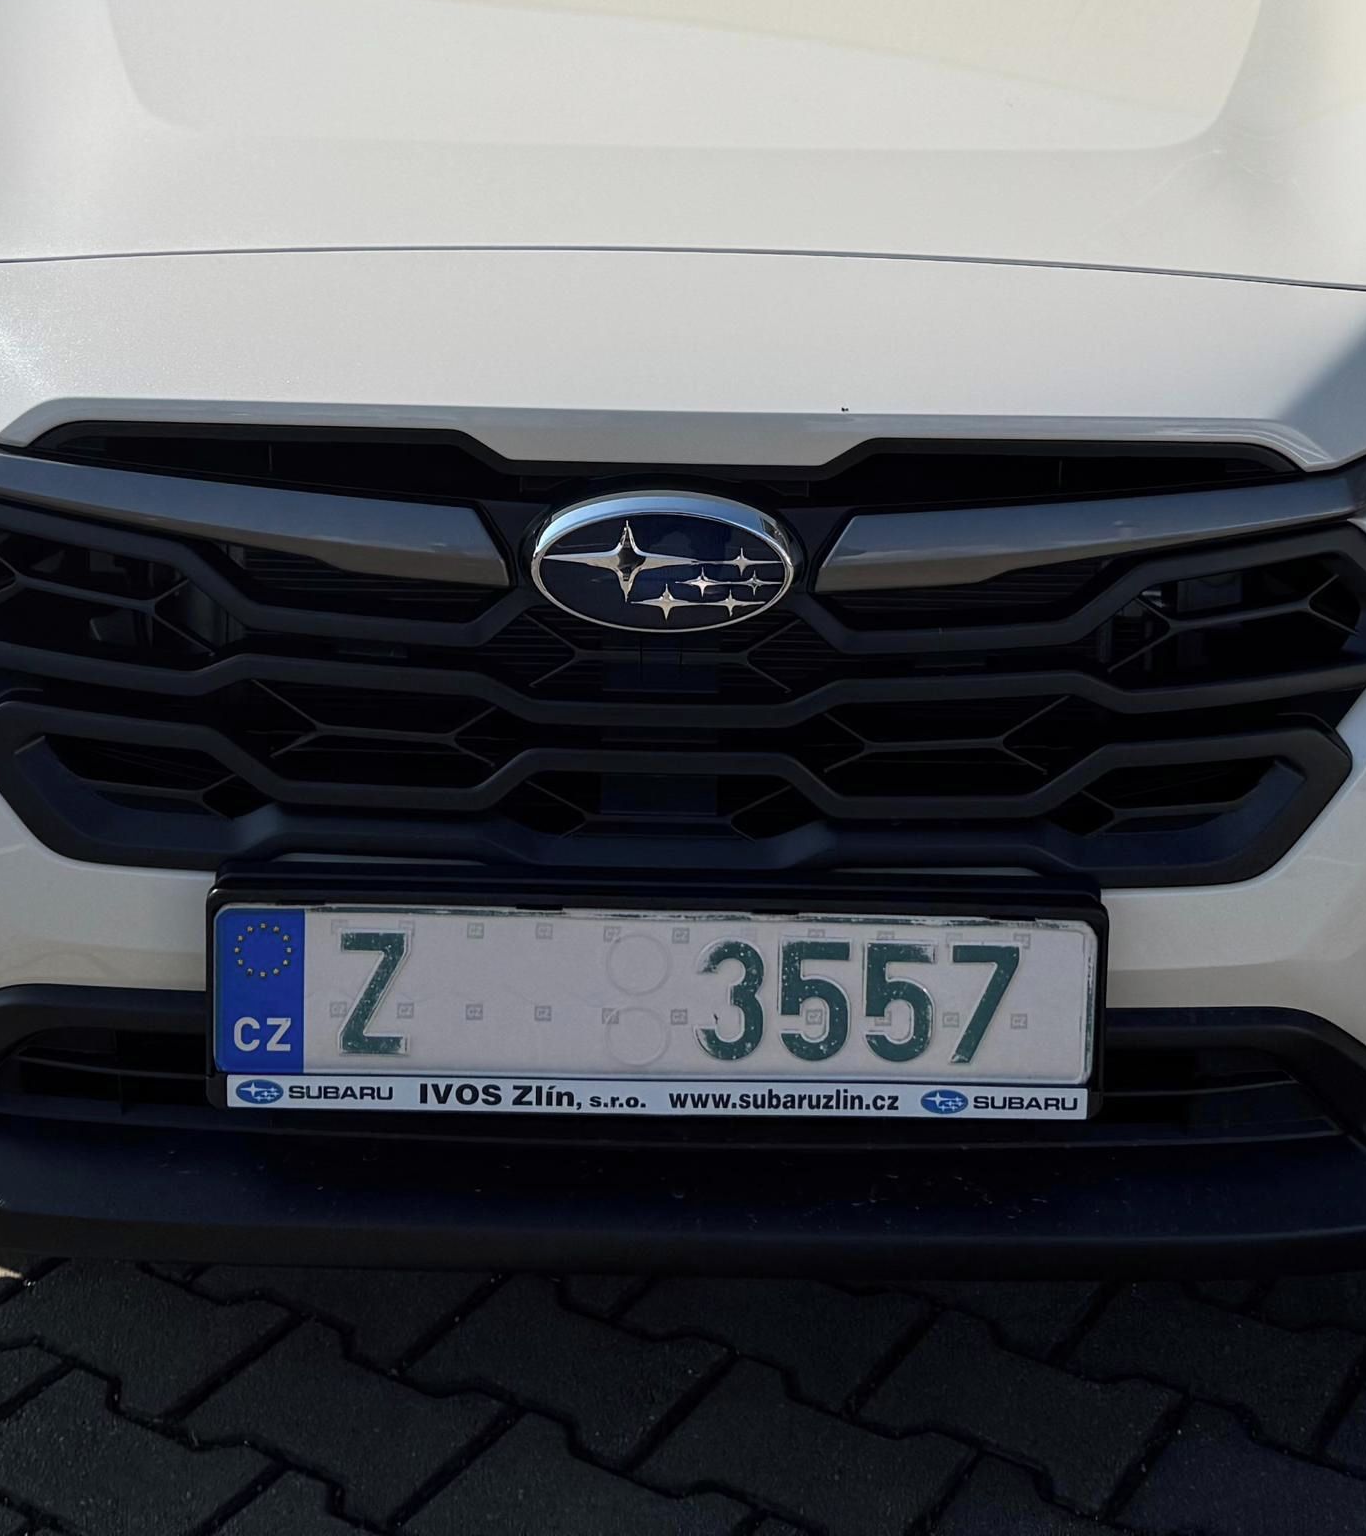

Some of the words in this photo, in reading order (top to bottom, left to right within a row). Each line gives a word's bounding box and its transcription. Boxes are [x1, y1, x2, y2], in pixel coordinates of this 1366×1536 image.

[340, 931, 408, 1056] Z
[694, 939, 1021, 1064] 3557
[233, 1016, 292, 1052] CZ
[287, 1084, 394, 1101] SUBARU
[419, 1082, 502, 1106] IVOS
[512, 1083, 583, 1111] Zlín,
[588, 1094, 647, 1109] s.r.o.
[668, 1088, 899, 1112] www.subaruzlin.cz
[972, 1095, 1078, 1112] SUBARU
